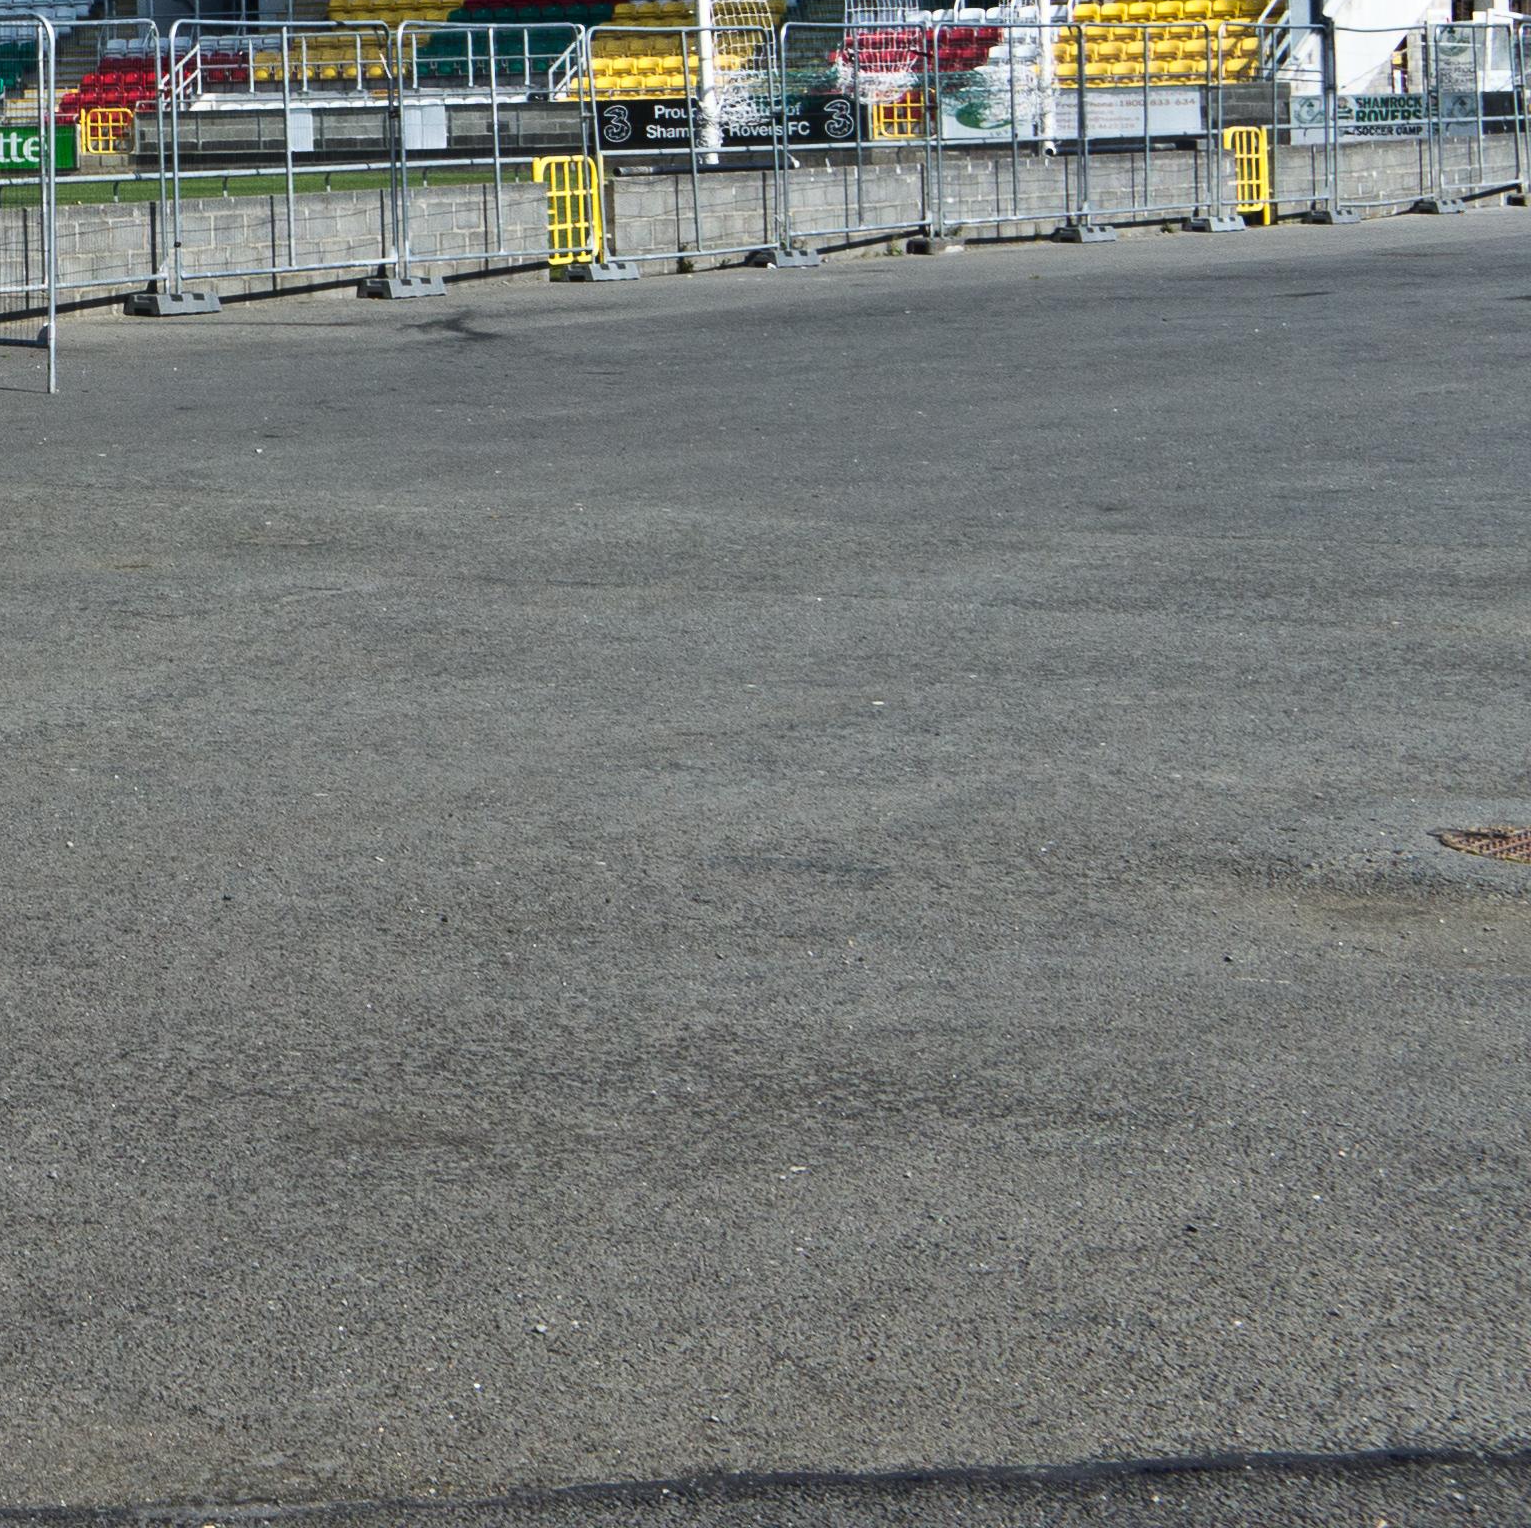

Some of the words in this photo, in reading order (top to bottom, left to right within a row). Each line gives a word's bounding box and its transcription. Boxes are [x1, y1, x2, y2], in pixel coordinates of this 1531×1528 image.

[1355, 97, 1423, 108] SHAMROCK
[788, 122, 810, 136] FC
[1355, 125, 1394, 136] SOCCER
